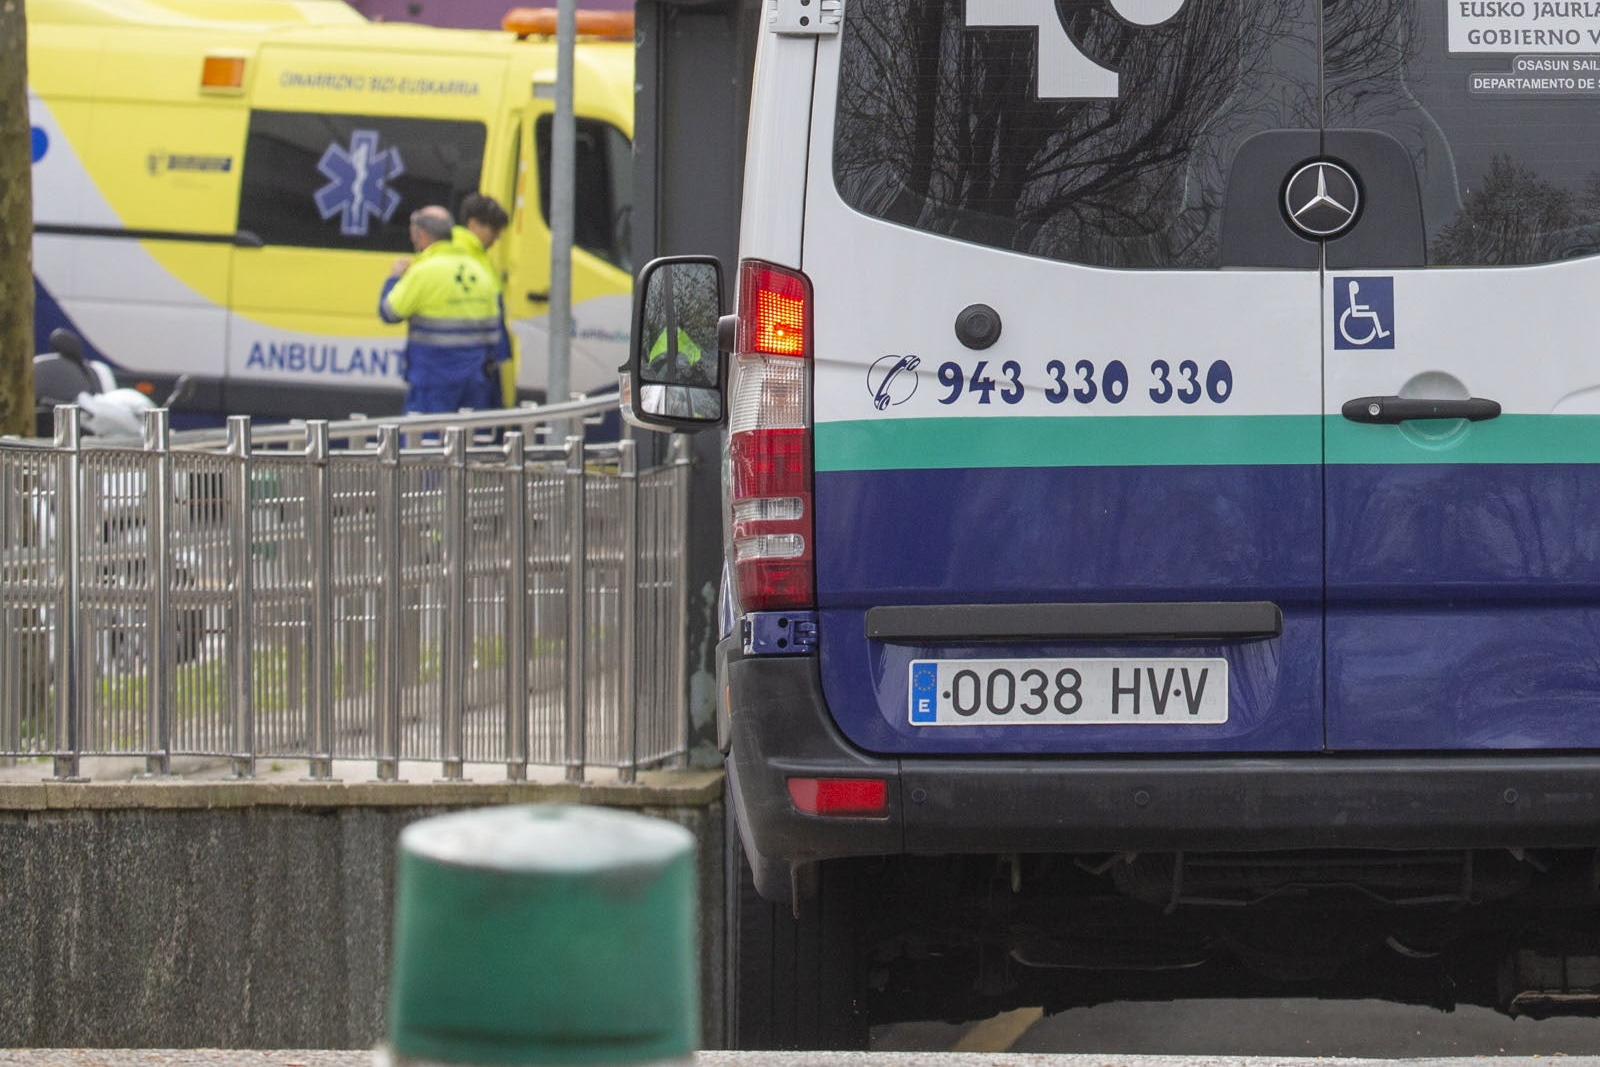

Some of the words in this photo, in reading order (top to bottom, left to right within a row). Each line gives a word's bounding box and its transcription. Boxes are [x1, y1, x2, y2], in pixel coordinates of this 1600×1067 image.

[1460, 1, 1525, 18] EUSKO
[1468, 29, 1581, 46] GOBIERNO
[1517, 60, 1570, 71] OSASUN
[1474, 78, 1575, 89] DEPARTAMENTO
[1578, 78, 1595, 89] DE
[937, 359, 1025, 405] 943
[1044, 359, 1129, 405] 330
[1149, 359, 1233, 405] 330
[919, 699, 930, 712] E
[952, 668, 1083, 716] 0038
[1111, 668, 1209, 715] HVV
